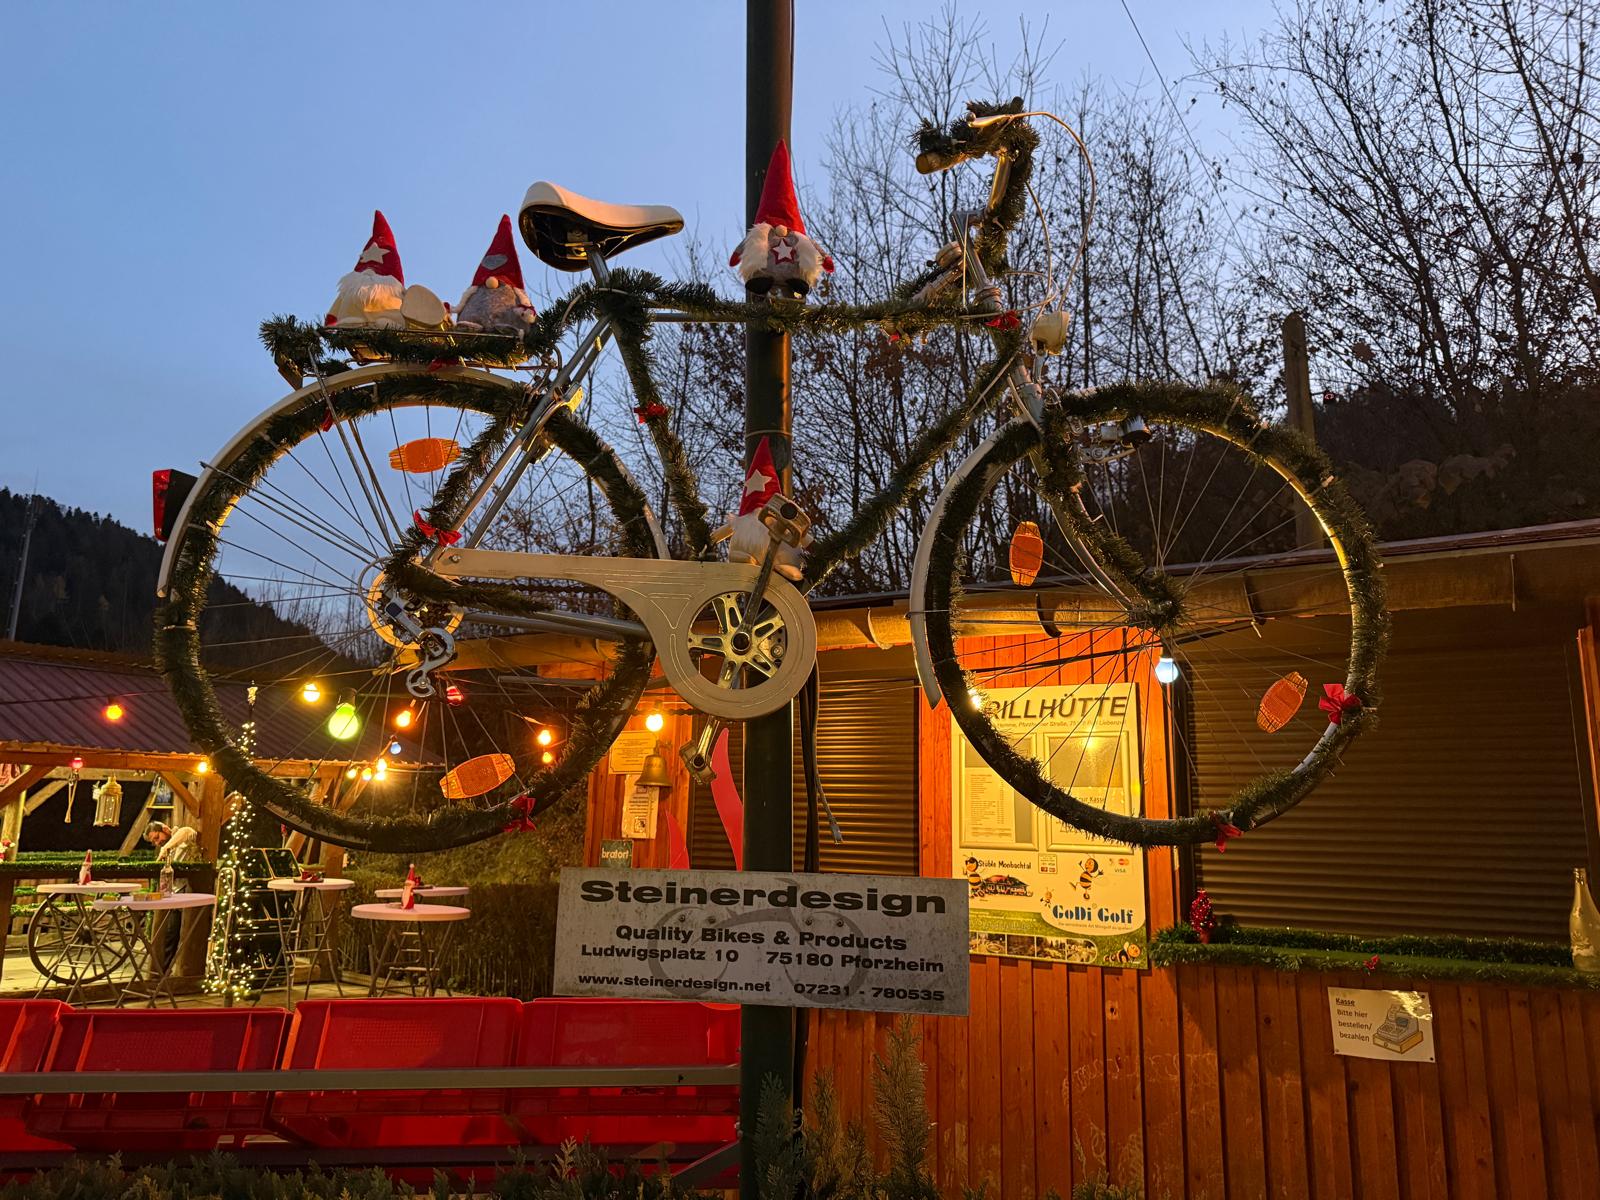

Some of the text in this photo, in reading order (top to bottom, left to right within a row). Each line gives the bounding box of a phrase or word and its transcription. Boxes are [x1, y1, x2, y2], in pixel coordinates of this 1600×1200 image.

[991, 693, 1127, 719] RILLHÜTTE
[580, 879, 947, 917] Steinerdesign
[1052, 904, 1092, 921] GoDi
[1097, 907, 1133, 924] Golf
[615, 924, 907, 951] Quality Bikes & Products
[581, 944, 945, 973] Ludwigsplatz 10 75180 Pforzheim
[578, 973, 771, 992] www.steinerdesign.net
[793, 982, 852, 996] 07231
[871, 986, 945, 1002] 780535
[1336, 997, 1356, 1006] Kasse
[1337, 1009, 1368, 1018] Bitte hier
[1338, 1021, 1372, 1031] bestellen/
[1339, 1032, 1370, 1043] bezahlen
